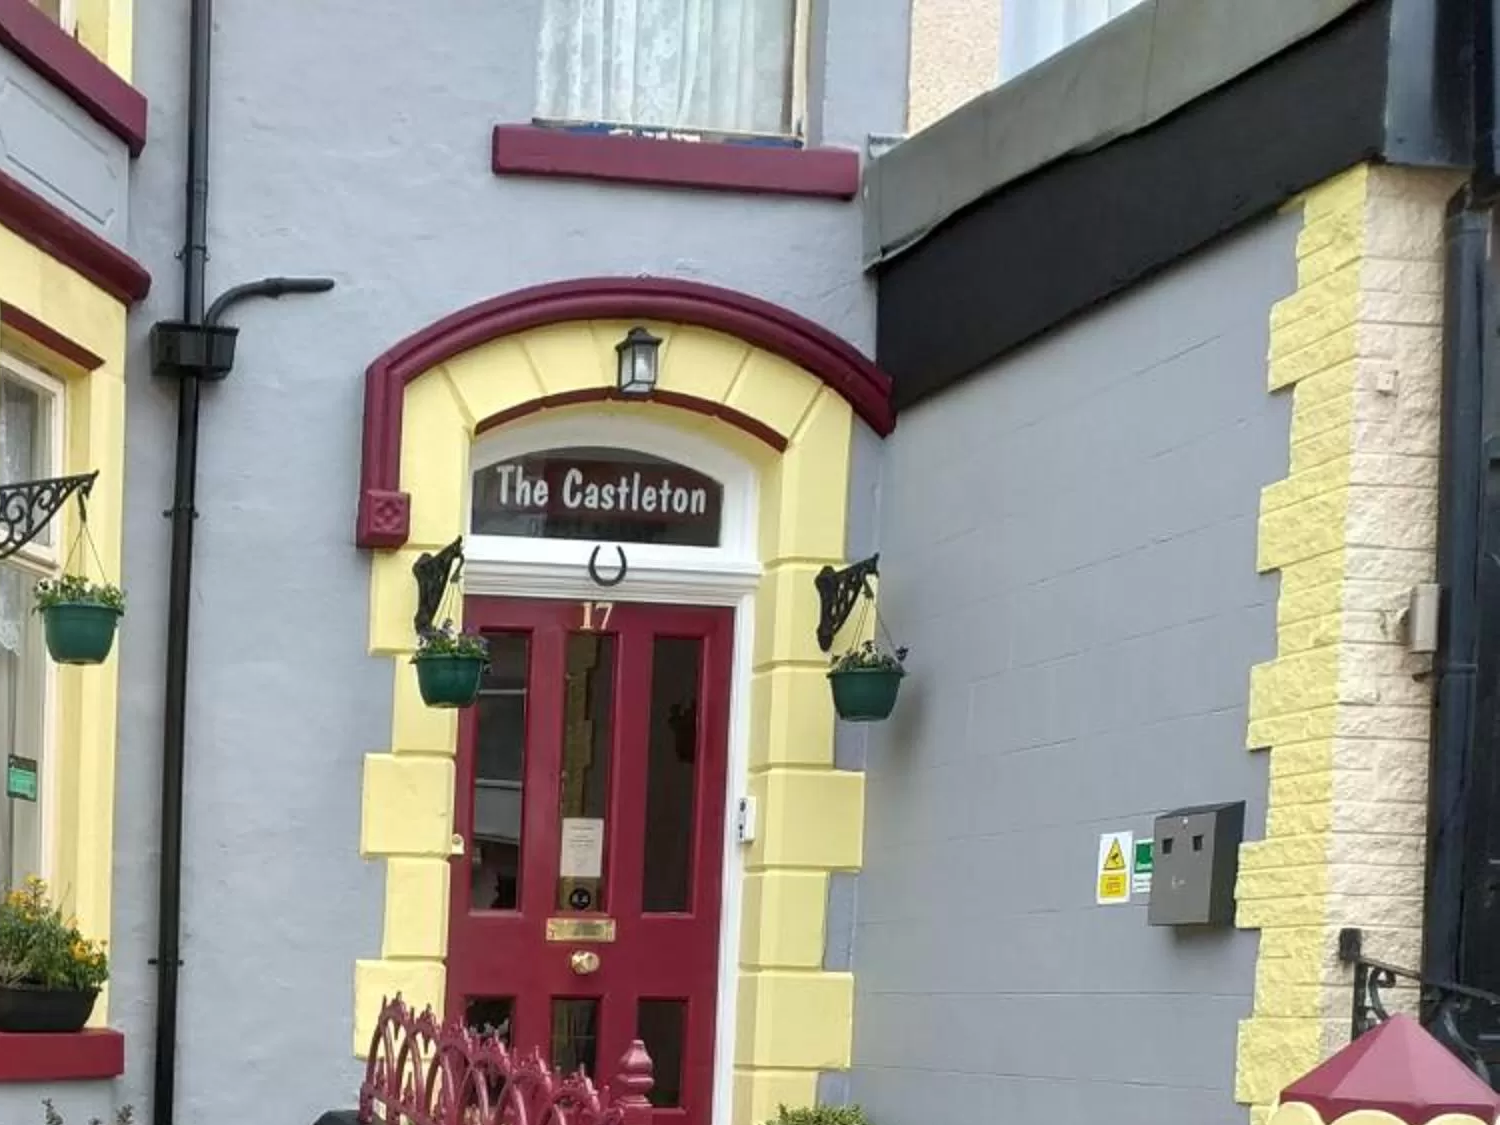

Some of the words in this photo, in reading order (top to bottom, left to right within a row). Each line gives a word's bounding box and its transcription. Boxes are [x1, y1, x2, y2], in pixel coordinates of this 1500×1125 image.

[496, 465, 549, 507] The
[563, 467, 706, 515] Castleton
[580, 601, 613, 630] 17
